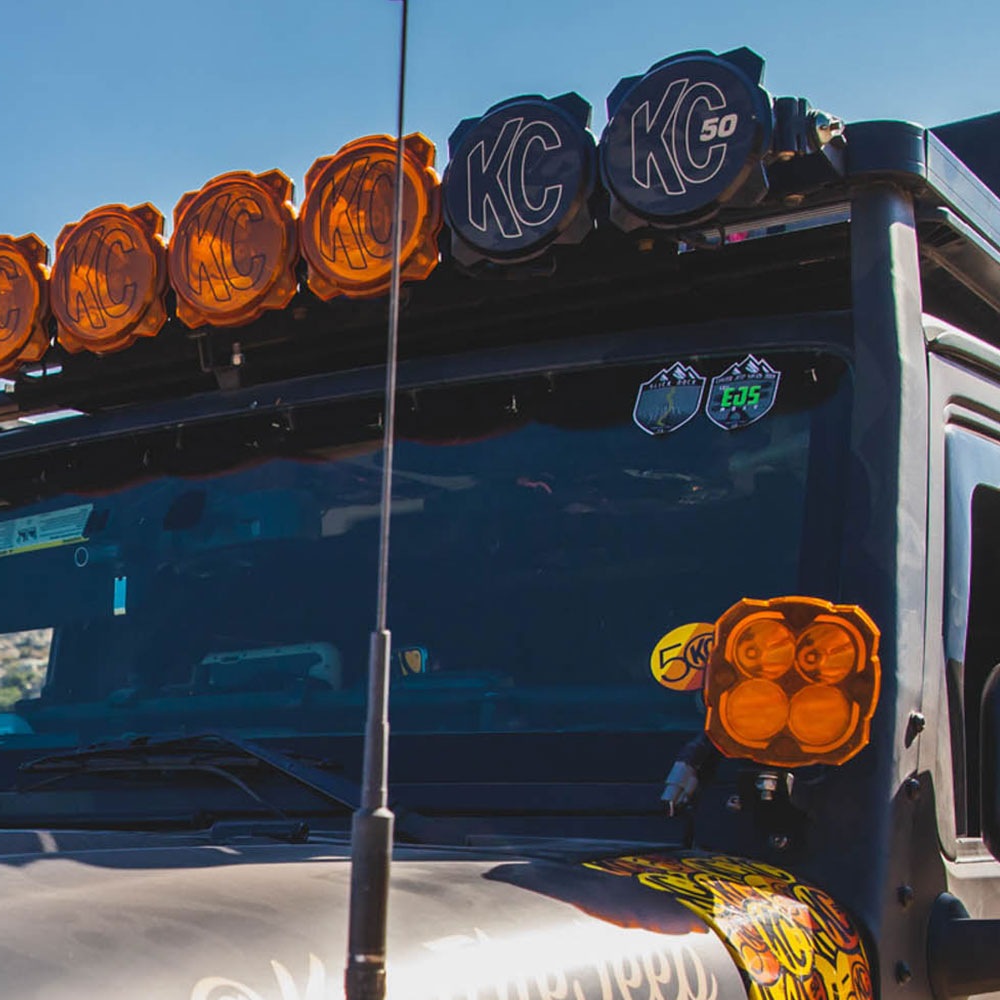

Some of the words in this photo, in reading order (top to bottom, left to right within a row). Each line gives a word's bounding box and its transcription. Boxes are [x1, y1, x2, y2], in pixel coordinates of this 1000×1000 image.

[467, 117, 562, 238] KC
[631, 78, 727, 195] KC
[700, 113, 738, 142] 50
[186, 193, 266, 302] KC
[320, 156, 407, 270] KC
[64, 225, 137, 329] KC
[720, 385, 761, 408] EJS
